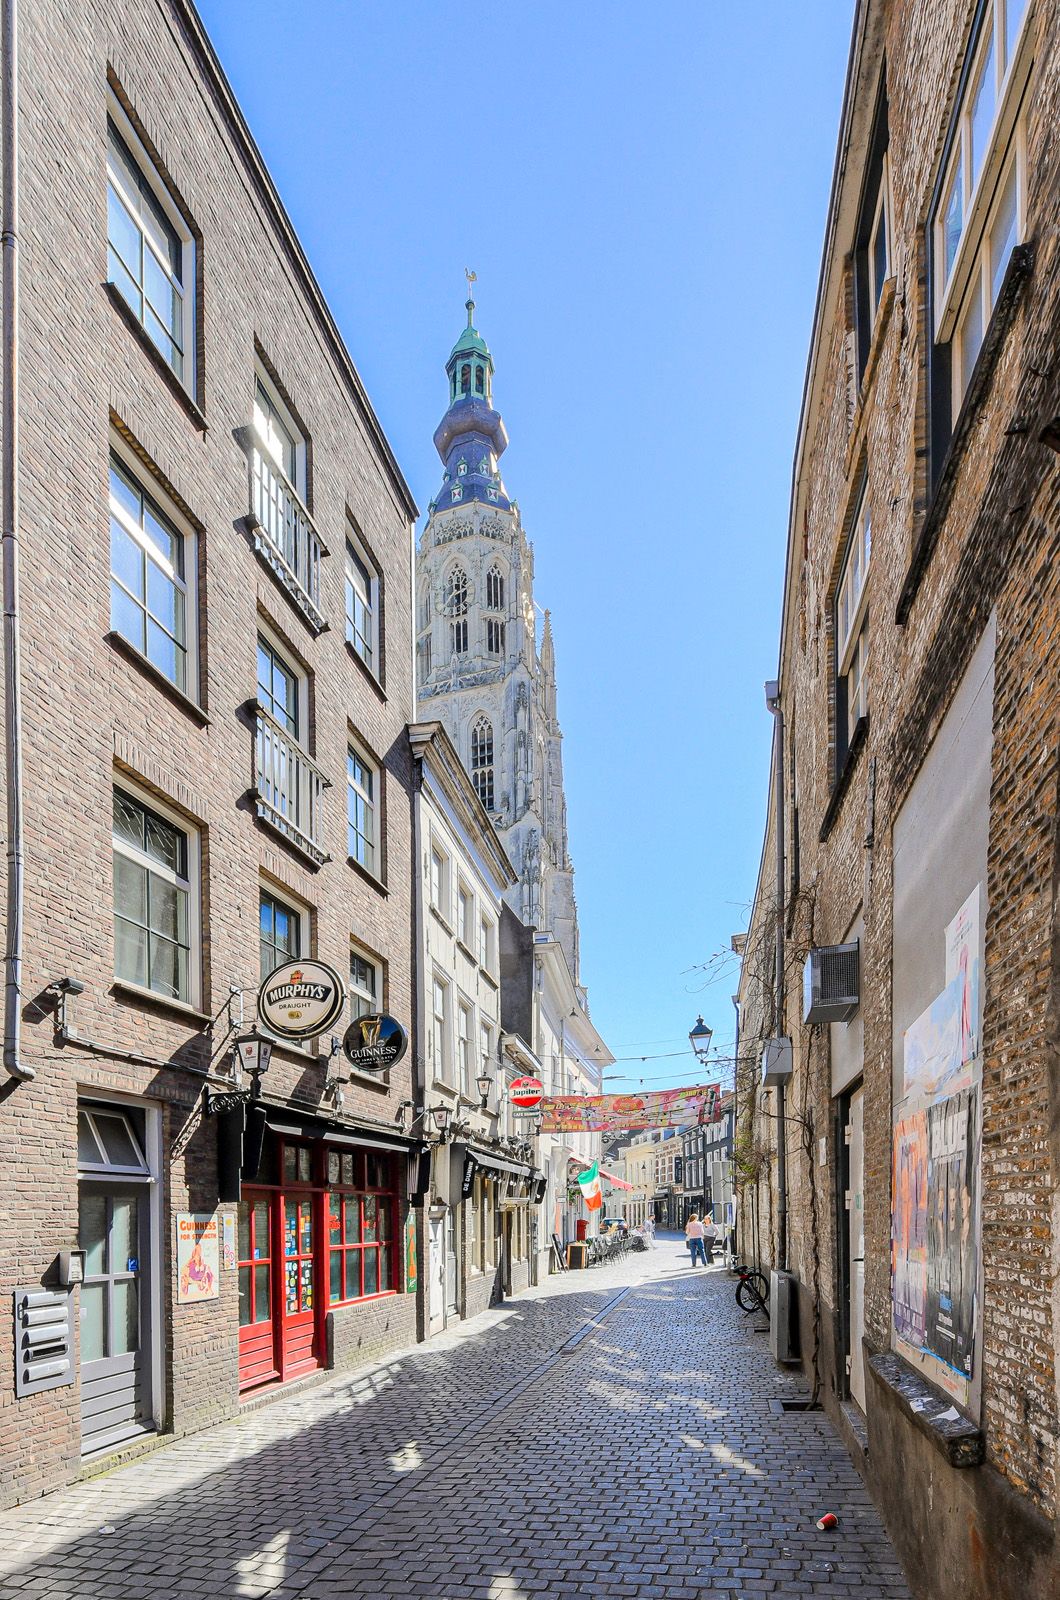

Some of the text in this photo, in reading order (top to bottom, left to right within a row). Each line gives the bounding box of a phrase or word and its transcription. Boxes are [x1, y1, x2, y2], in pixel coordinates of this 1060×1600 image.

[269, 984, 325, 1002] MURPHY'S
[350, 1046, 397, 1058] GUINNESS
[932, 1110, 967, 1159] BLUE
[463, 1183, 470, 1192] DE
[180, 1220, 216, 1231] GUINNESS
